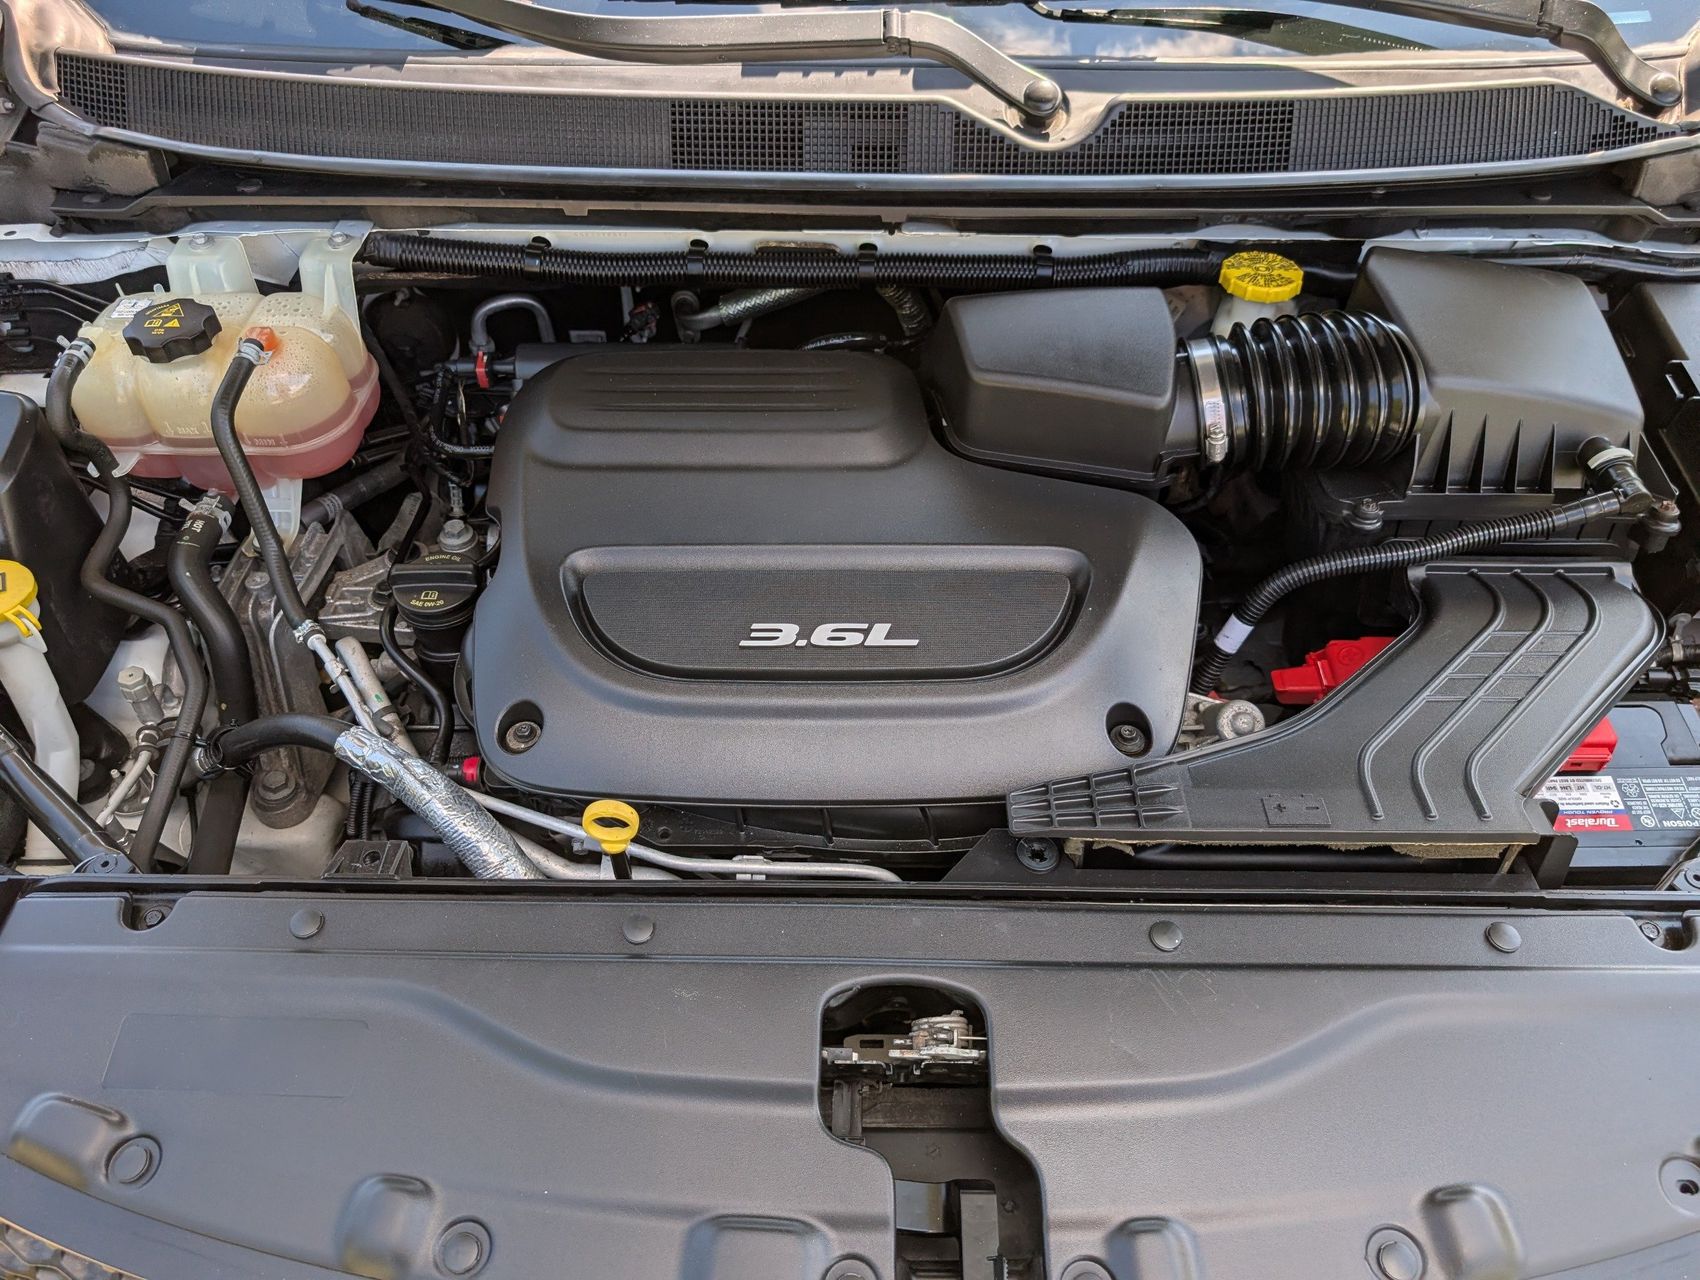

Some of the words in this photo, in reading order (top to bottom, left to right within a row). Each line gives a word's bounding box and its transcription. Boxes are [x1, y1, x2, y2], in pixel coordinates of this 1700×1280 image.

[410, 599, 424, 607] SAE
[424, 599, 444, 607] 0W-20
[738, 623, 920, 647] 3.6L
[1565, 817, 1619, 828] Duralast
